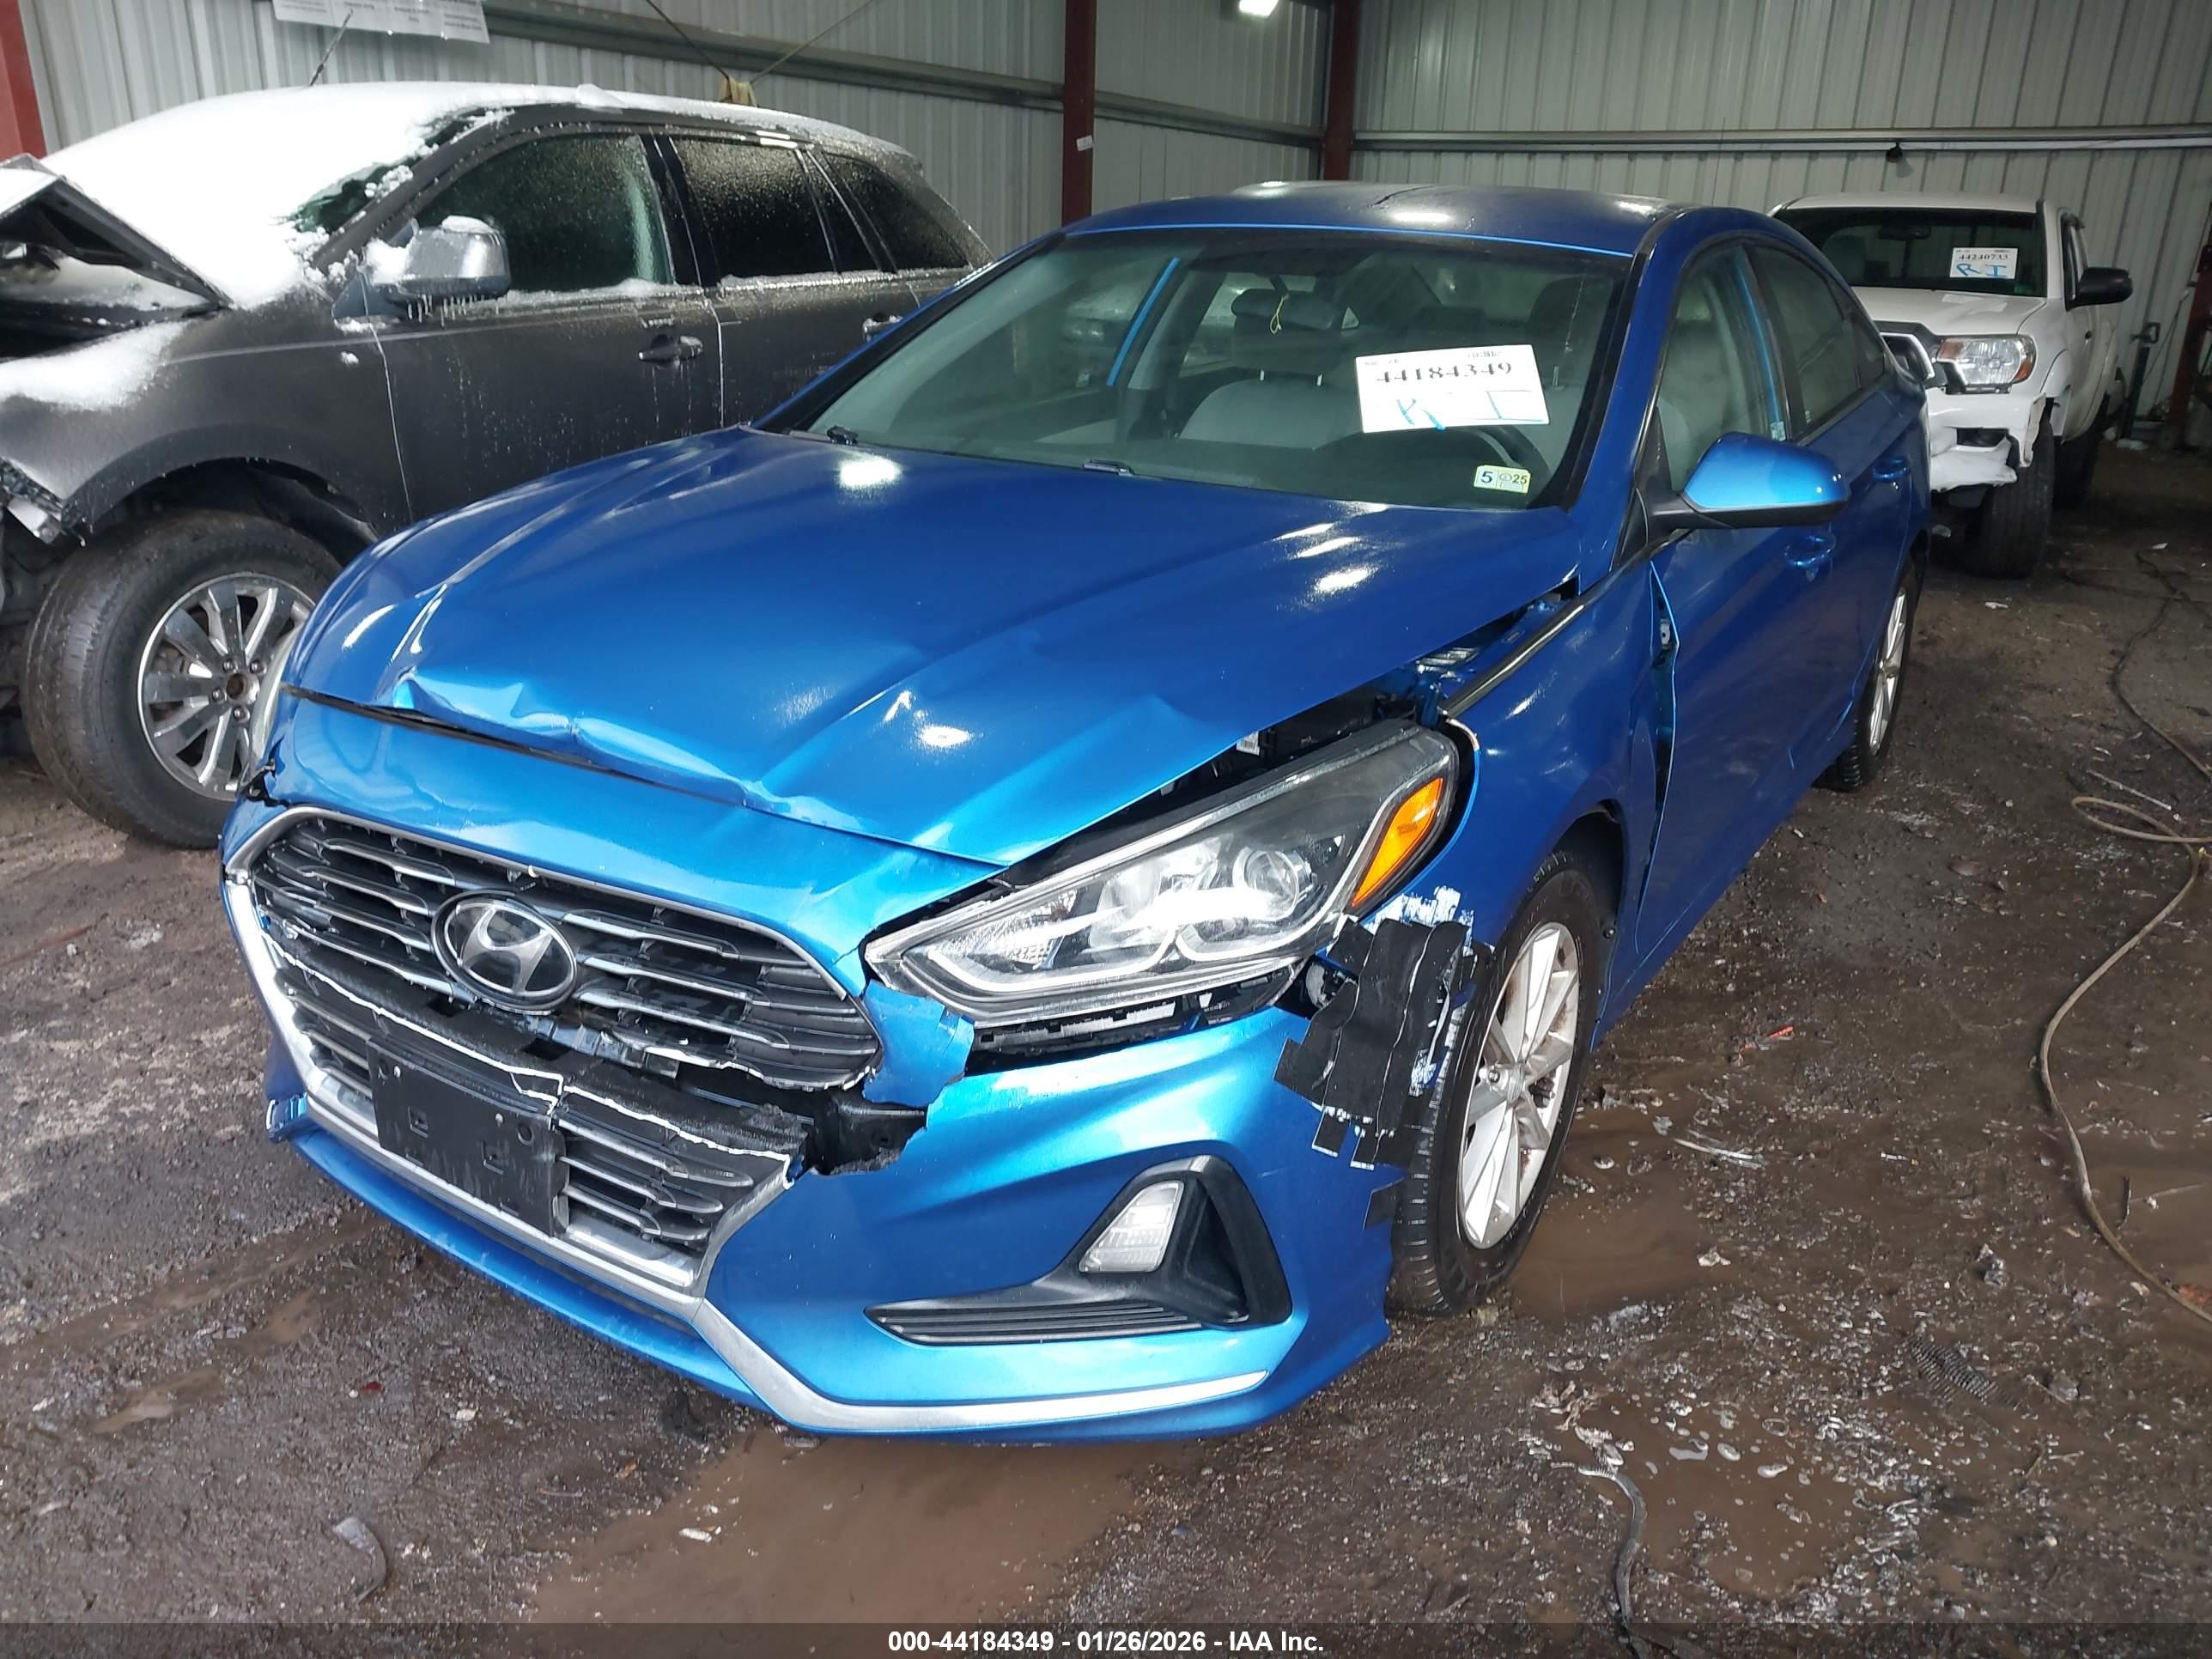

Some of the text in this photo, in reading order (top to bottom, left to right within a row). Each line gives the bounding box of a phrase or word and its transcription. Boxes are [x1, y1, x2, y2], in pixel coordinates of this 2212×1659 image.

[1376, 362, 1512, 384] 44184349
[1480, 471, 1528, 484] 5 25
